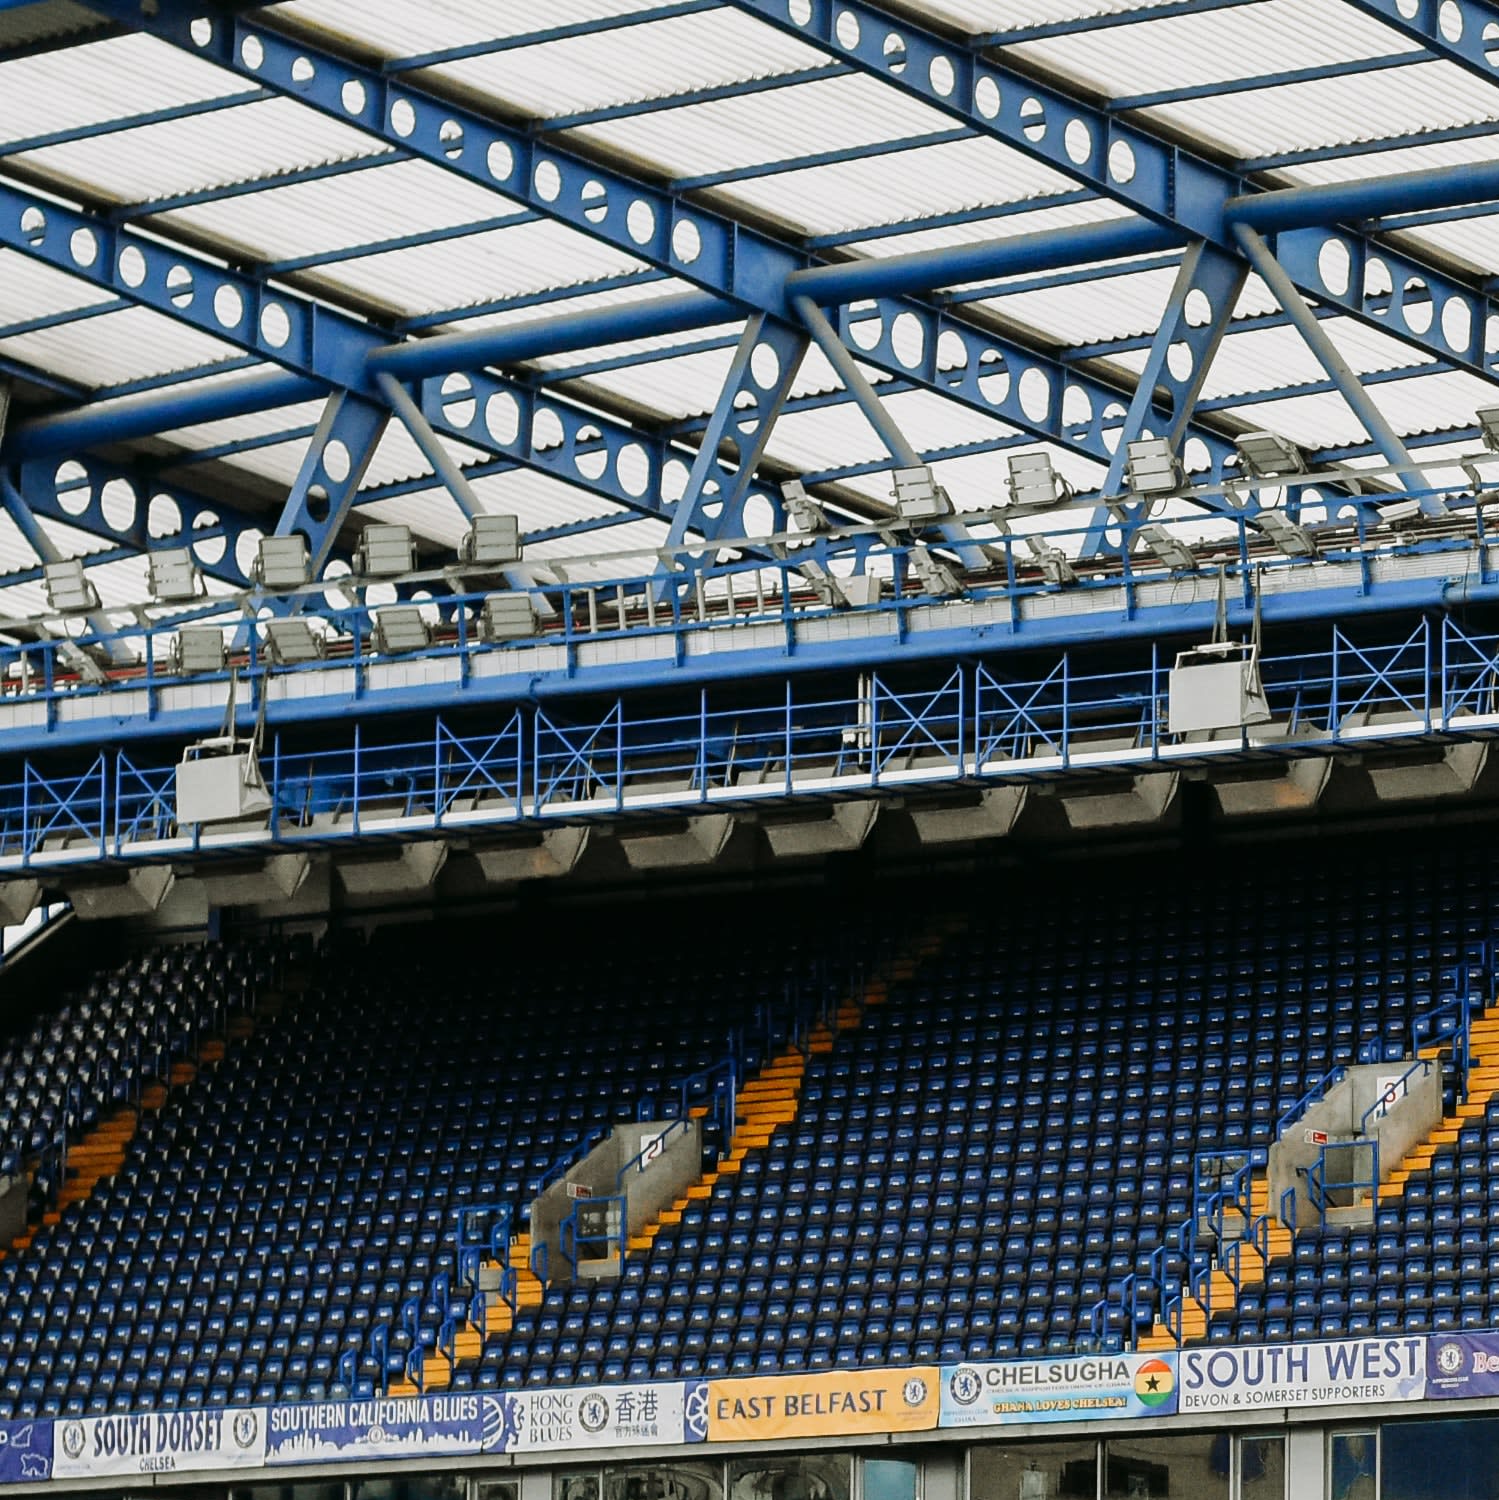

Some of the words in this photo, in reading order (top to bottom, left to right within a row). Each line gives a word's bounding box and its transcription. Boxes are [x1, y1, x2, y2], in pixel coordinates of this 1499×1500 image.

[1384, 1082, 1396, 1103] 3
[648, 1140, 660, 1161] 2
[985, 1361, 1131, 1386] CHELSUGHA
[1185, 1346, 1310, 1389] SOUTH
[1325, 1340, 1421, 1382] WEST
[529, 1394, 574, 1411] HONG
[614, 1390, 659, 1424] 香港
[716, 1396, 776, 1420] EAST
[784, 1389, 888, 1417] BELFAST
[992, 1402, 1034, 1415] GHANA
[1035, 1399, 1071, 1412] LOVES
[1185, 1393, 1229, 1408] DEVON
[1232, 1393, 1241, 1405] &
[1245, 1389, 1310, 1404] SOMERSET
[1311, 1384, 1386, 1401] SUPPORTERS
[271, 1403, 346, 1432] SOUTHERN
[349, 1399, 430, 1426] CALIFORNIA
[432, 1396, 478, 1422] BLUES
[529, 1410, 573, 1426] KONG
[93, 1415, 152, 1457] SOUTH
[157, 1410, 225, 1456] DORSET
[529, 1426, 573, 1443] BLUES
[139, 1457, 176, 1473] CHELSEA
